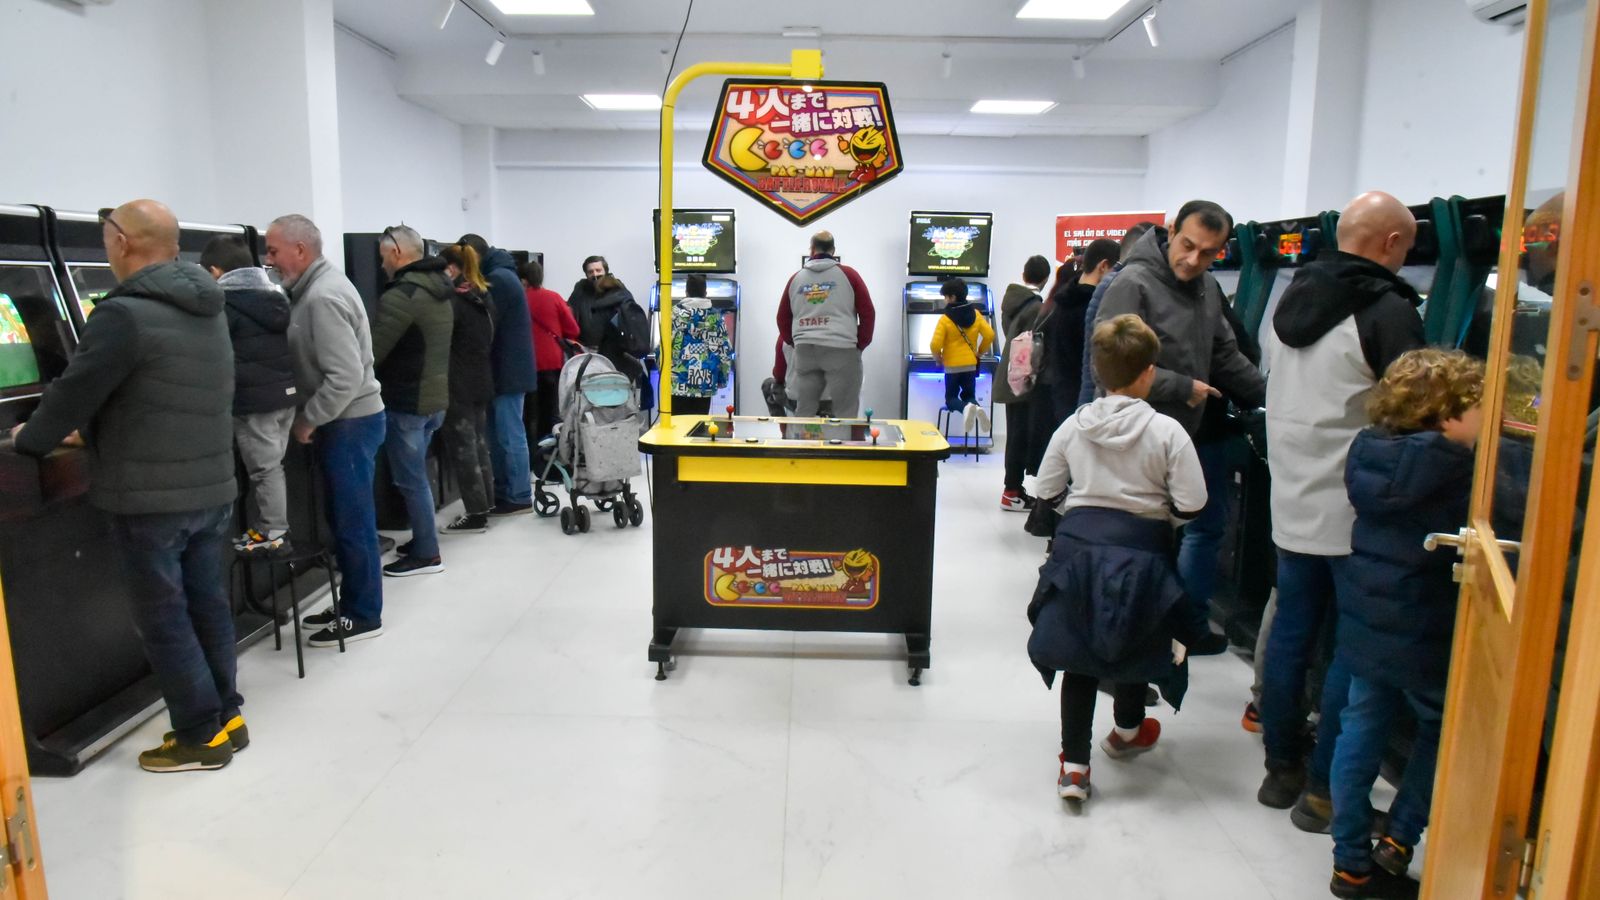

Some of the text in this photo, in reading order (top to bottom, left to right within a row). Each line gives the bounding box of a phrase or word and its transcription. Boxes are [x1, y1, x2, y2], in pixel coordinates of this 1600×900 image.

[726, 88, 825, 120] 4人まで
[770, 165, 834, 177] PAC-MAN
[799, 317, 830, 326] STAFF
